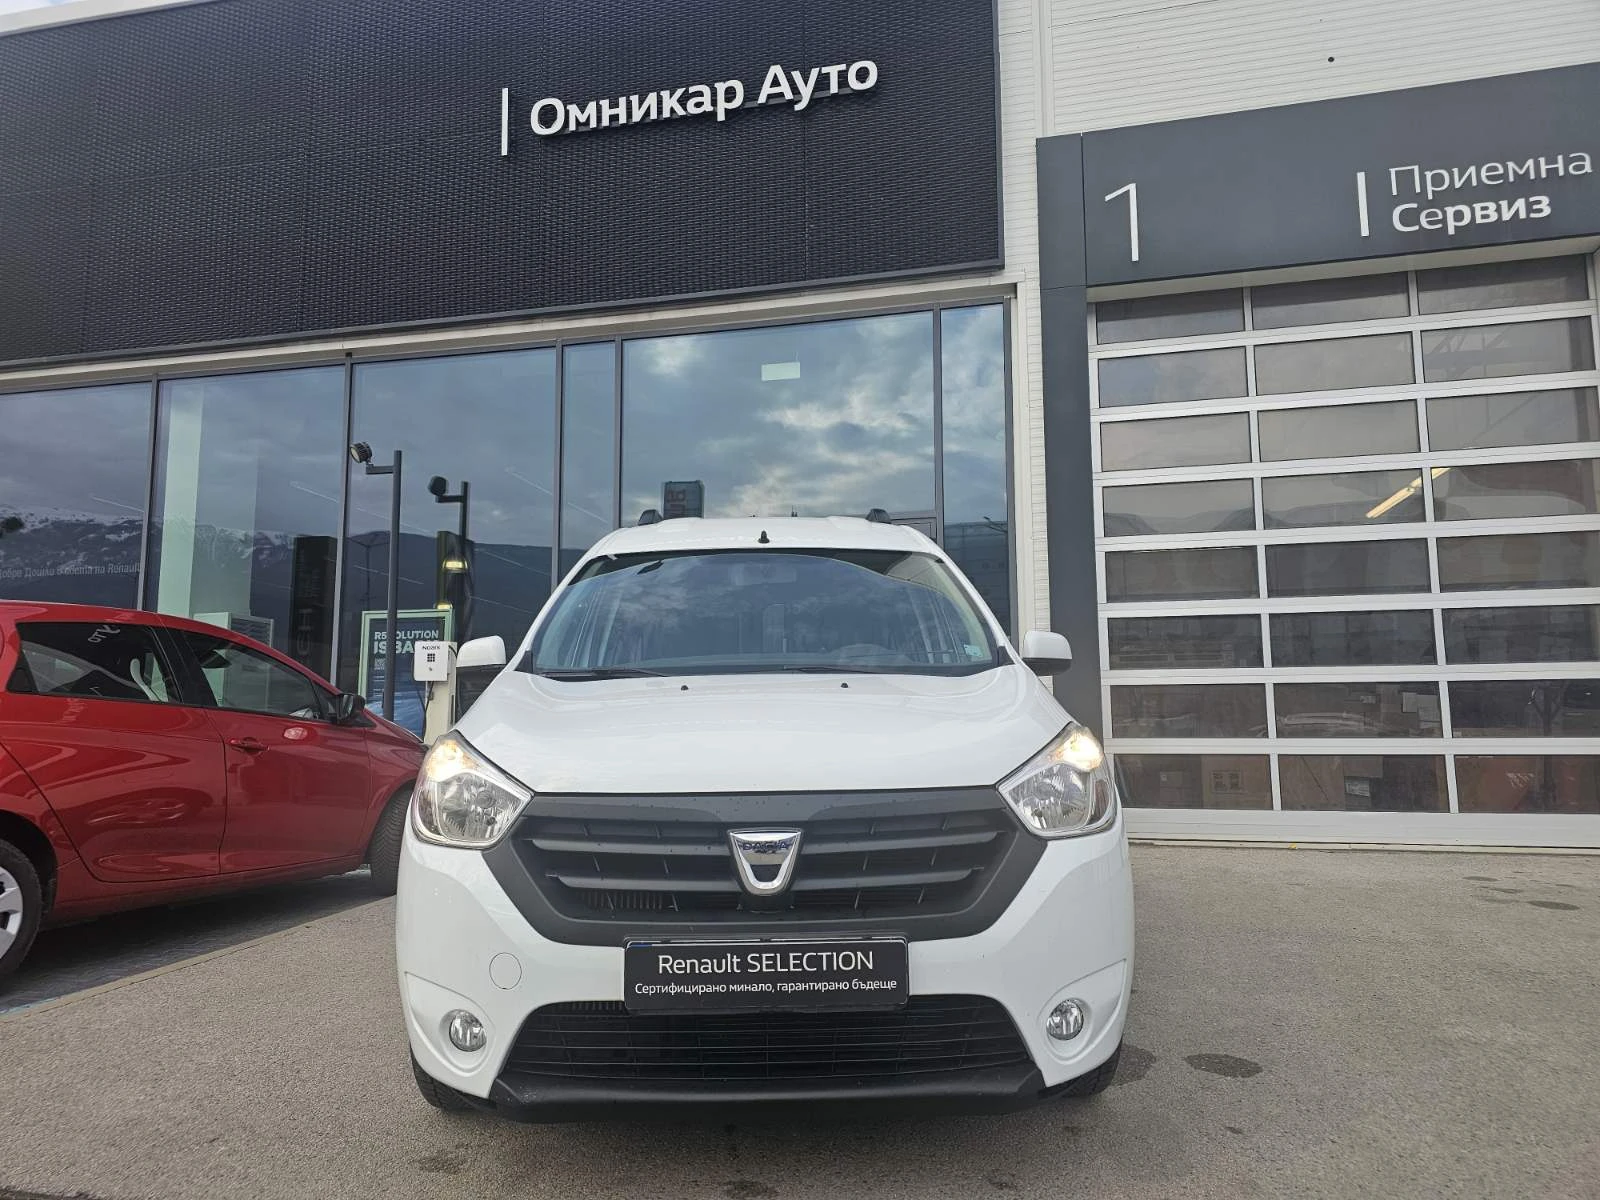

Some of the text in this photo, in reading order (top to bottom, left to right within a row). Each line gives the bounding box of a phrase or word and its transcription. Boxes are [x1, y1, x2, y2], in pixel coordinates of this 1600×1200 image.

[530, 60, 878, 136] Омникар Ауто
[1389, 152, 1593, 200] Приемна
[1104, 182, 1139, 261] 1
[1392, 195, 1552, 235] Сервиз
[374, 630, 439, 640] R5OLUTION
[658, 951, 873, 974] Renault SELECTION
[635, 978, 897, 996] Сертифицирано минало, гарантирано бъдеще
